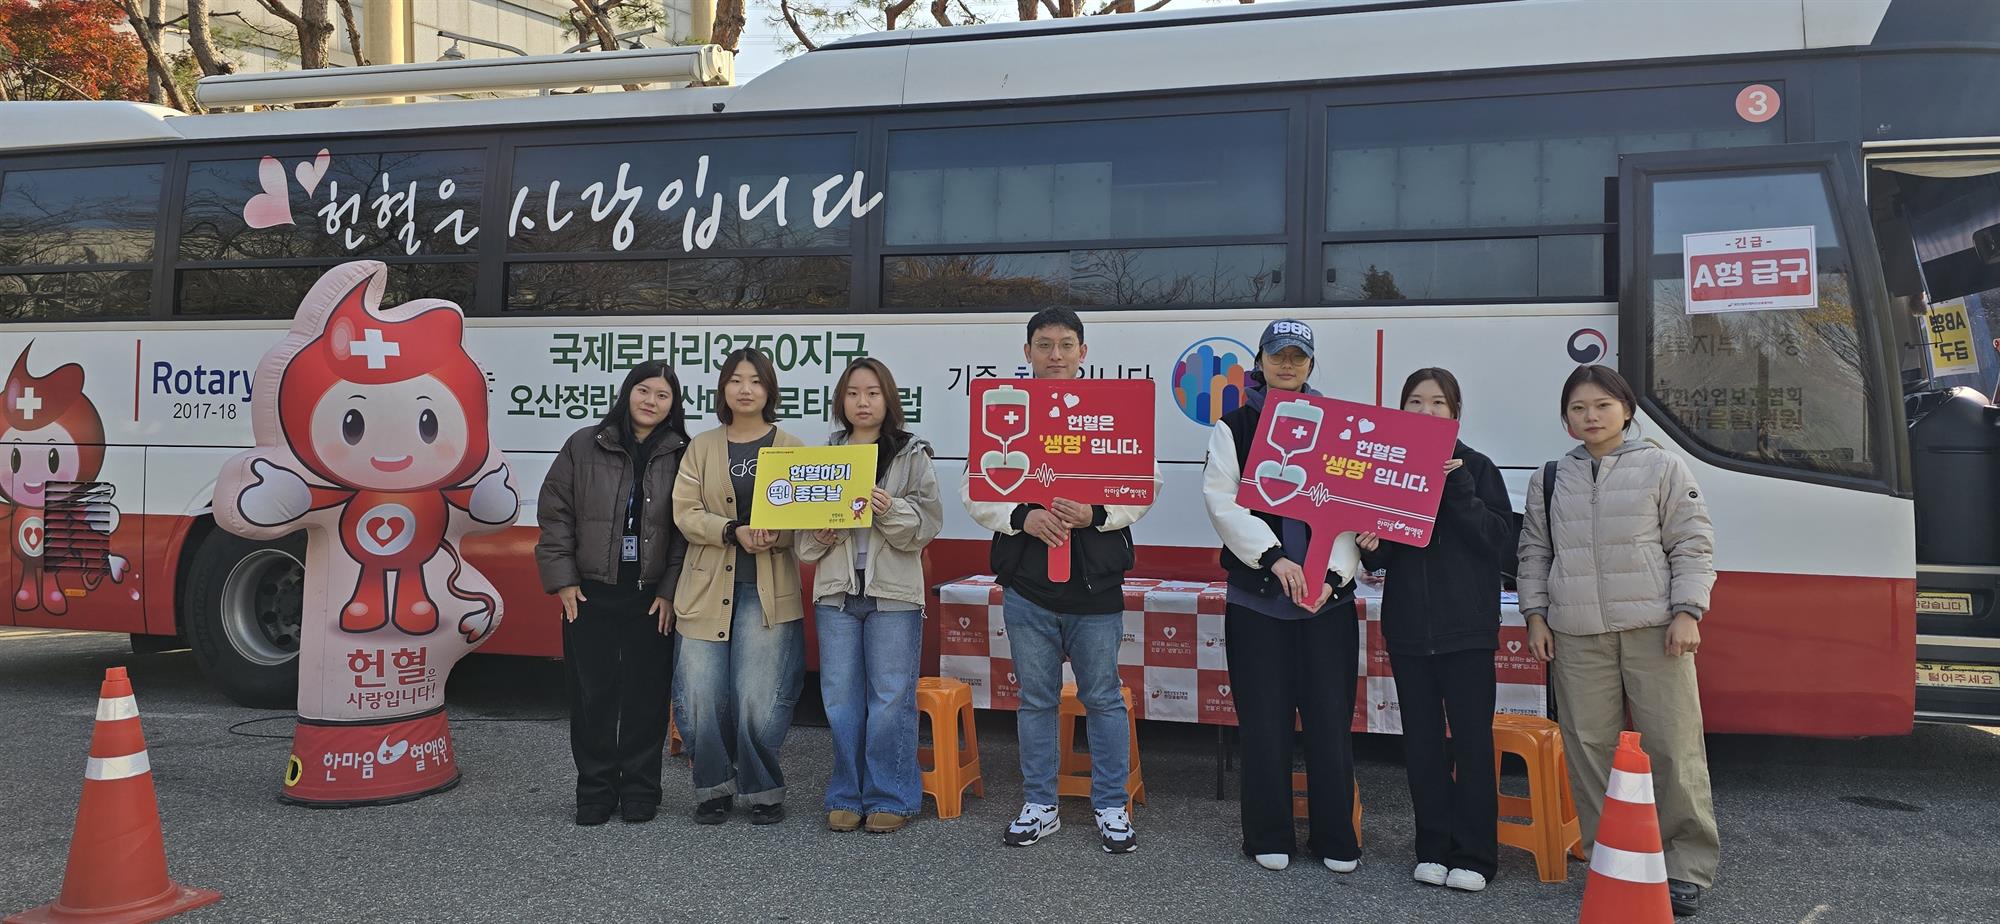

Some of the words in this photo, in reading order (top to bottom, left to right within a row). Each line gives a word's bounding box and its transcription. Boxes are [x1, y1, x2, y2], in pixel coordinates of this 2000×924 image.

[1748, 91, 1768, 115] 3
[317, 172, 480, 256] 헌혈은
[508, 155, 883, 252] 사랑입니다
[1734, 235, 1763, 248] 긴급
[1692, 261, 1743, 288] A형
[1750, 258, 1808, 285] 급구
[172, 402, 237, 420] 2017-18
[1067, 415, 1115, 432] 헌혈은
[1090, 438, 1143, 455] 입니다.
[1356, 440, 1408, 464] 헌혈은
[789, 463, 851, 482] 헌혈하기
[1375, 467, 1430, 493] 입니다.
[346, 682, 437, 710] 사랑입니다!
[322, 751, 375, 782] 한마음
[410, 736, 449, 773] 혈액원
